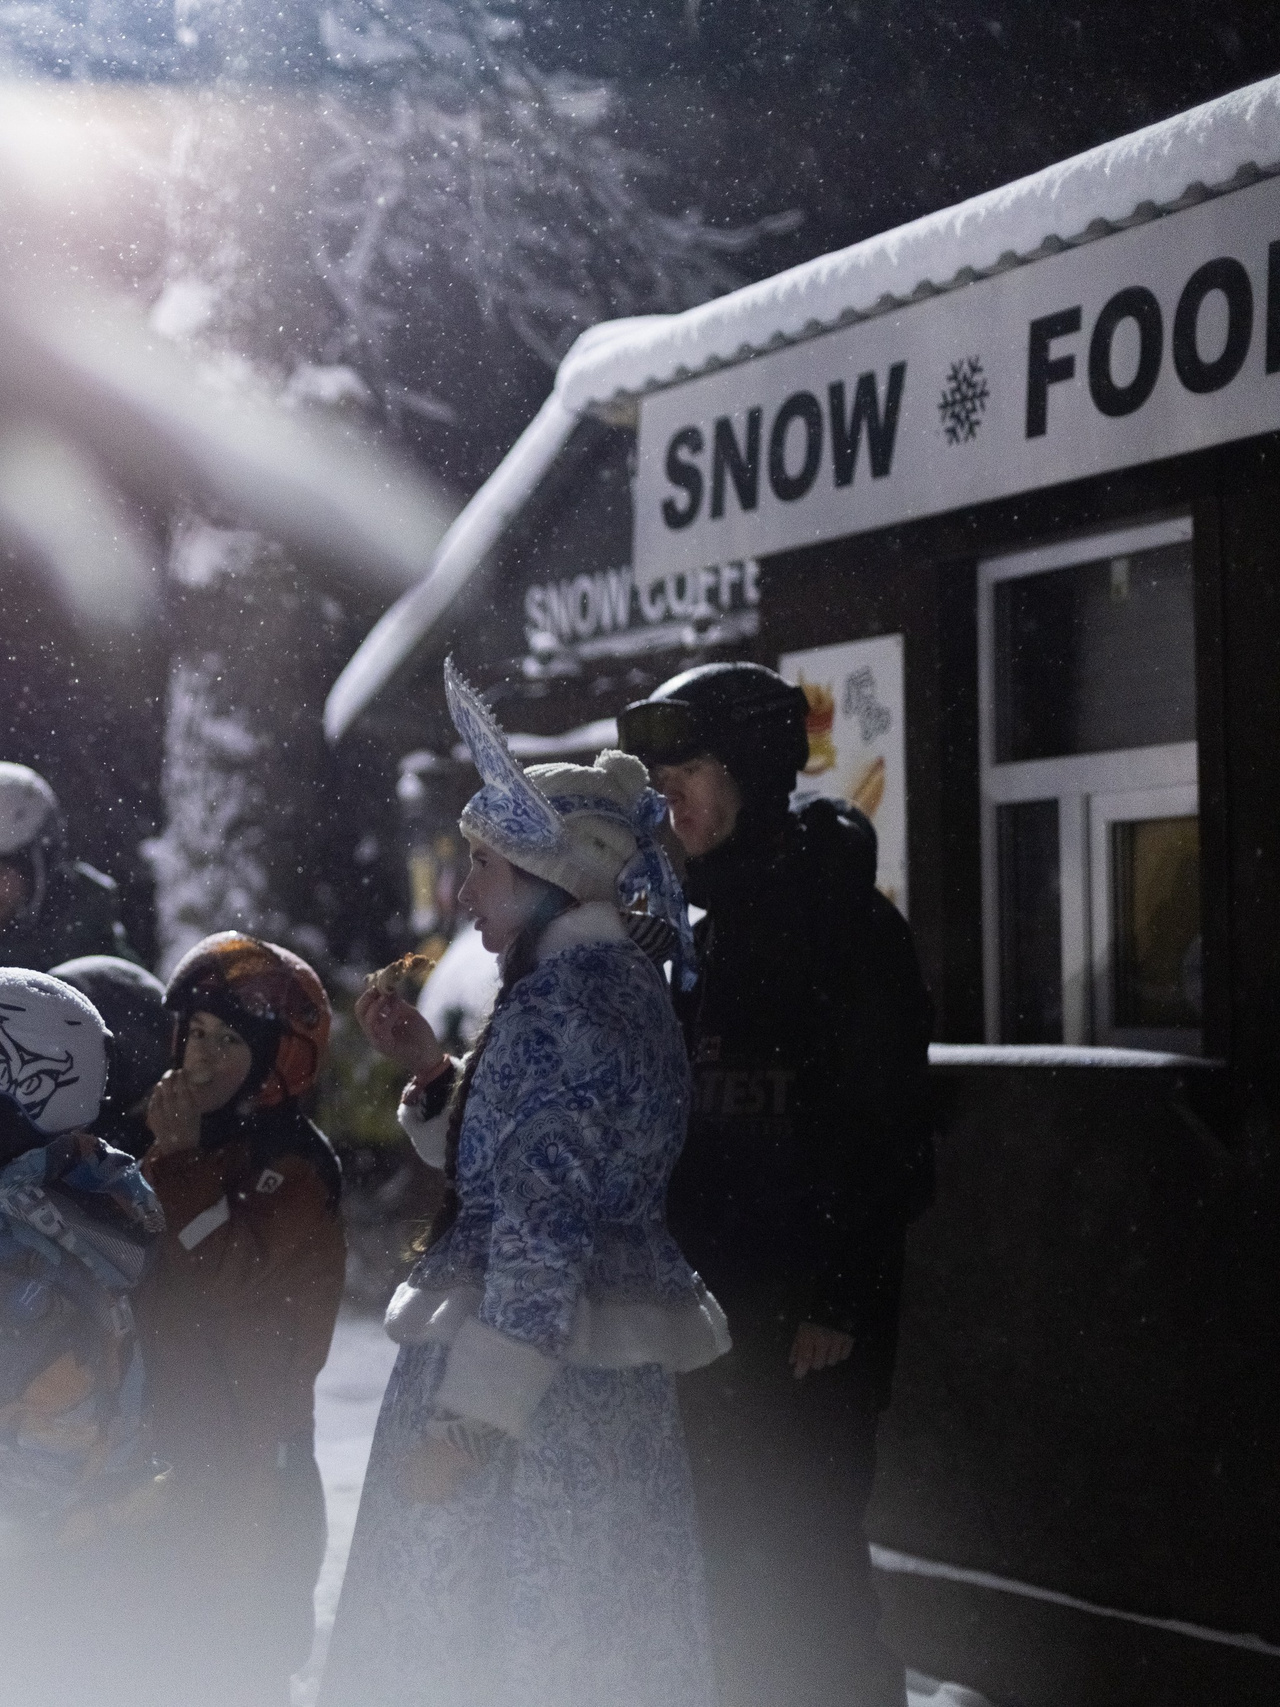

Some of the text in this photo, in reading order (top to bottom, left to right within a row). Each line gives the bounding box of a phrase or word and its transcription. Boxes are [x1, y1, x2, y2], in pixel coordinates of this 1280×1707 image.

[662, 239, 1280, 531] SNOW FOO
[524, 566, 633, 638] SNOW
